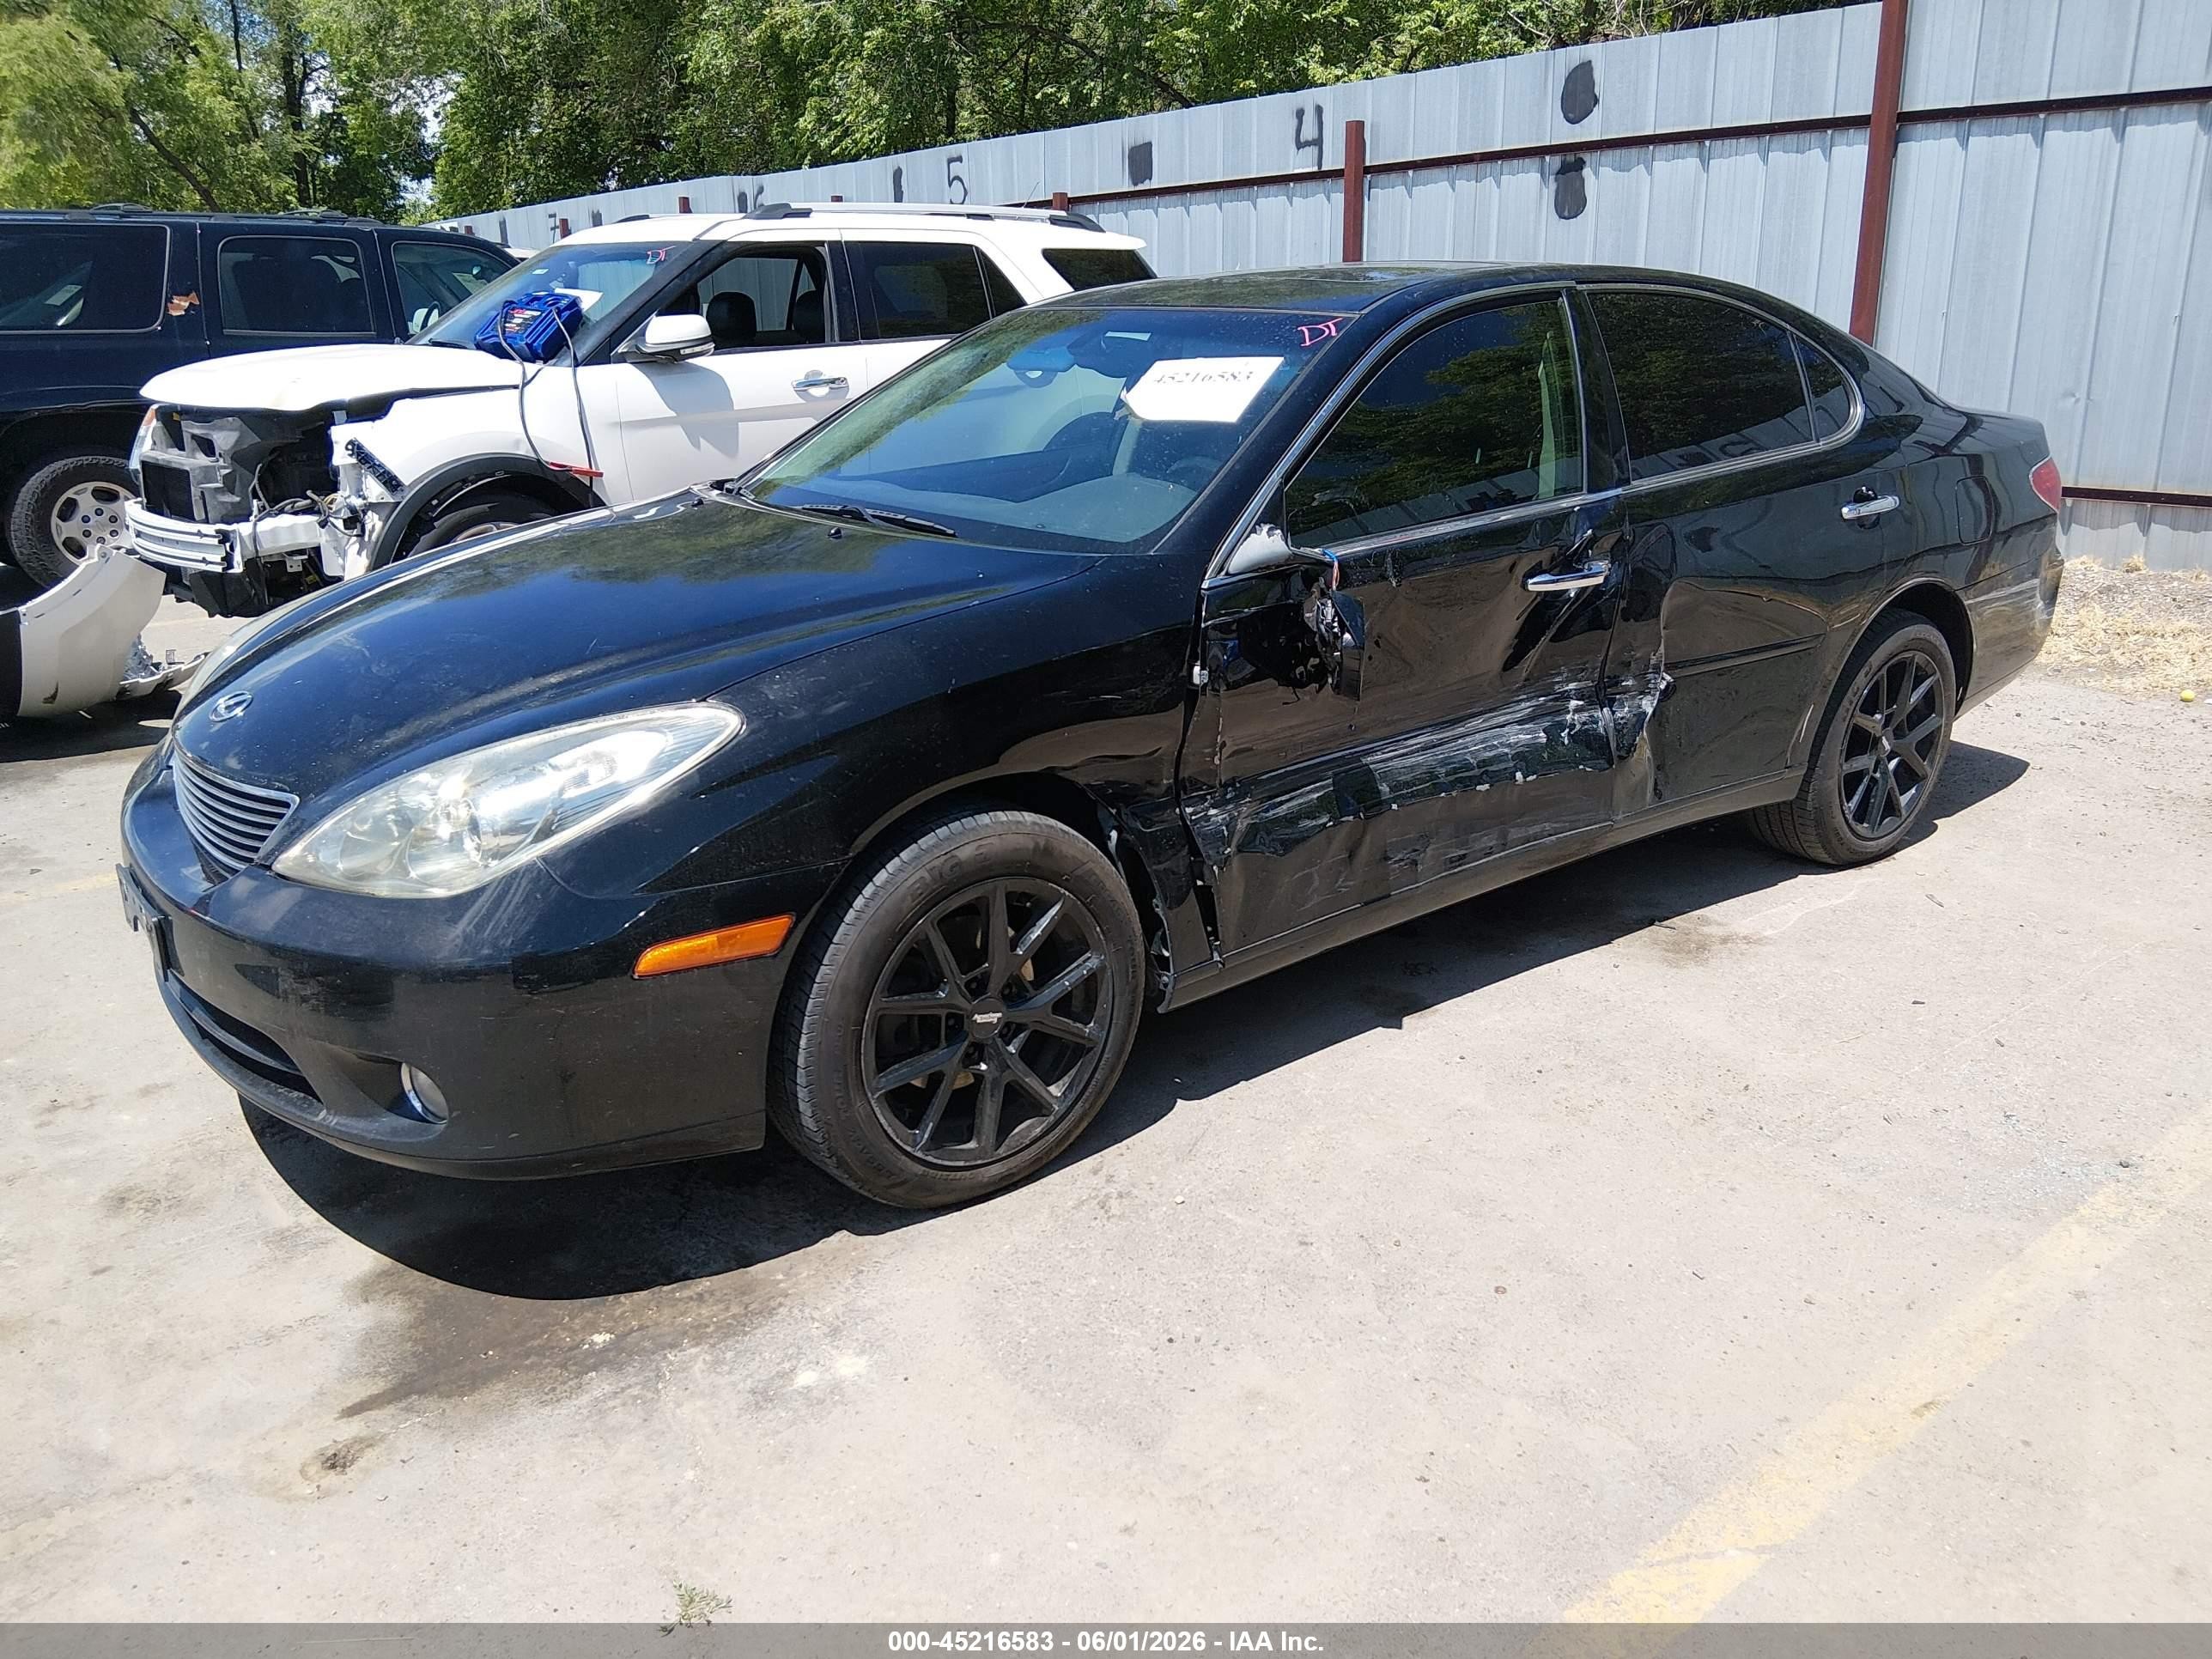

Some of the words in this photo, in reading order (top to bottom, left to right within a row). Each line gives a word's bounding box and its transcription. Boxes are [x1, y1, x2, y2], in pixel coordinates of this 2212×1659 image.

[1295, 104, 1323, 170] 4
[946, 155, 968, 205] 5
[1297, 317, 1344, 347] DT
